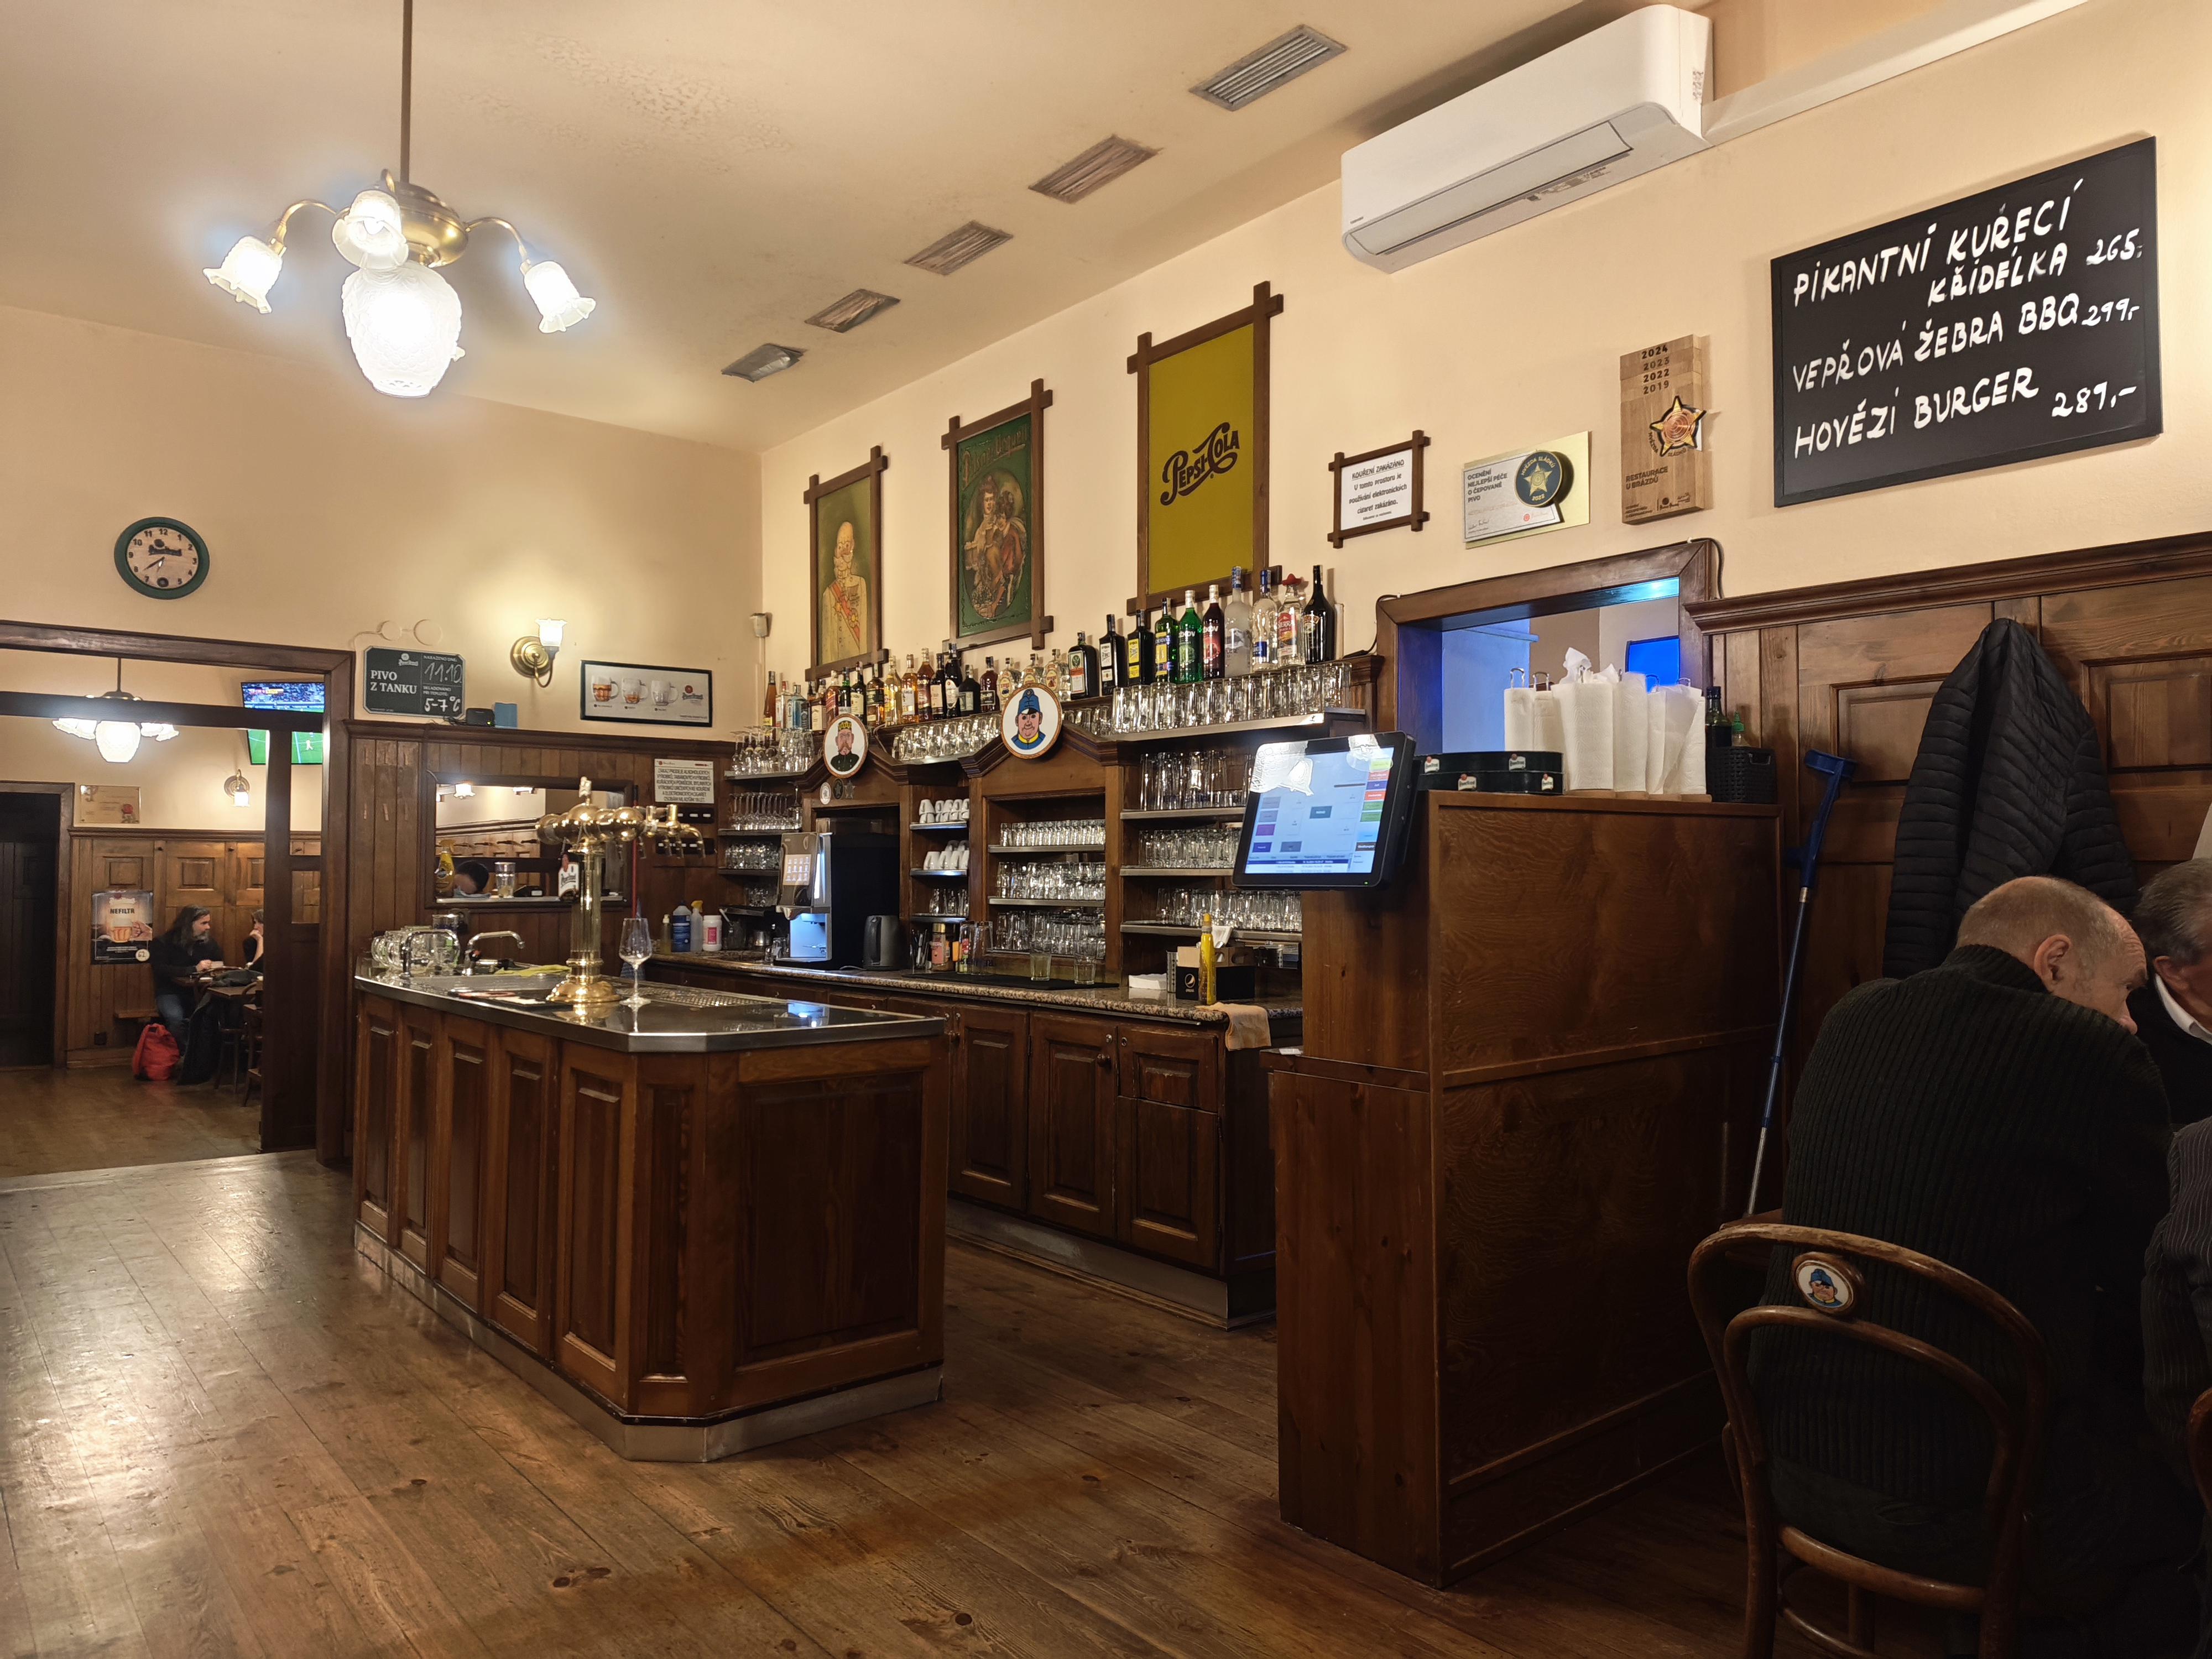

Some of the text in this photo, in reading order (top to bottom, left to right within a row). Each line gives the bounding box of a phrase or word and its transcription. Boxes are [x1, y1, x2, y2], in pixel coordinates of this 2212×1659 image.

[1946, 178, 2084, 265] KUŘECÍ
[1793, 293, 2140, 392] VEPŘOVÁ ŽEBRA BBQ 299,-
[1641, 345, 1668, 359] 2024
[1643, 356, 1670, 371] 2023
[1643, 368, 1670, 383] 2022
[1643, 380, 1669, 395] 2019
[1794, 387, 1899, 459] HOVĚZÍ
[1914, 367, 2039, 429] BURGER
[1352, 459, 1405, 479] KOUŘENÍ ZAKÁZÁNO
[1467, 468, 1491, 480] OCENĚNÍ
[1626, 466, 1668, 482] RESTAURACE
[1375, 475, 1395, 486] prostoru
[1467, 473, 1507, 488] NEJLEPŠÍ PÉČE
[1473, 481, 1502, 494] ČEPOVANÉ
[1349, 484, 1407, 504] používání elektronických
[1357, 499, 1399, 514] cigaret zakázáno.
[371, 670, 398, 681] PIVO
[370, 682, 417, 695] Z TANKU
